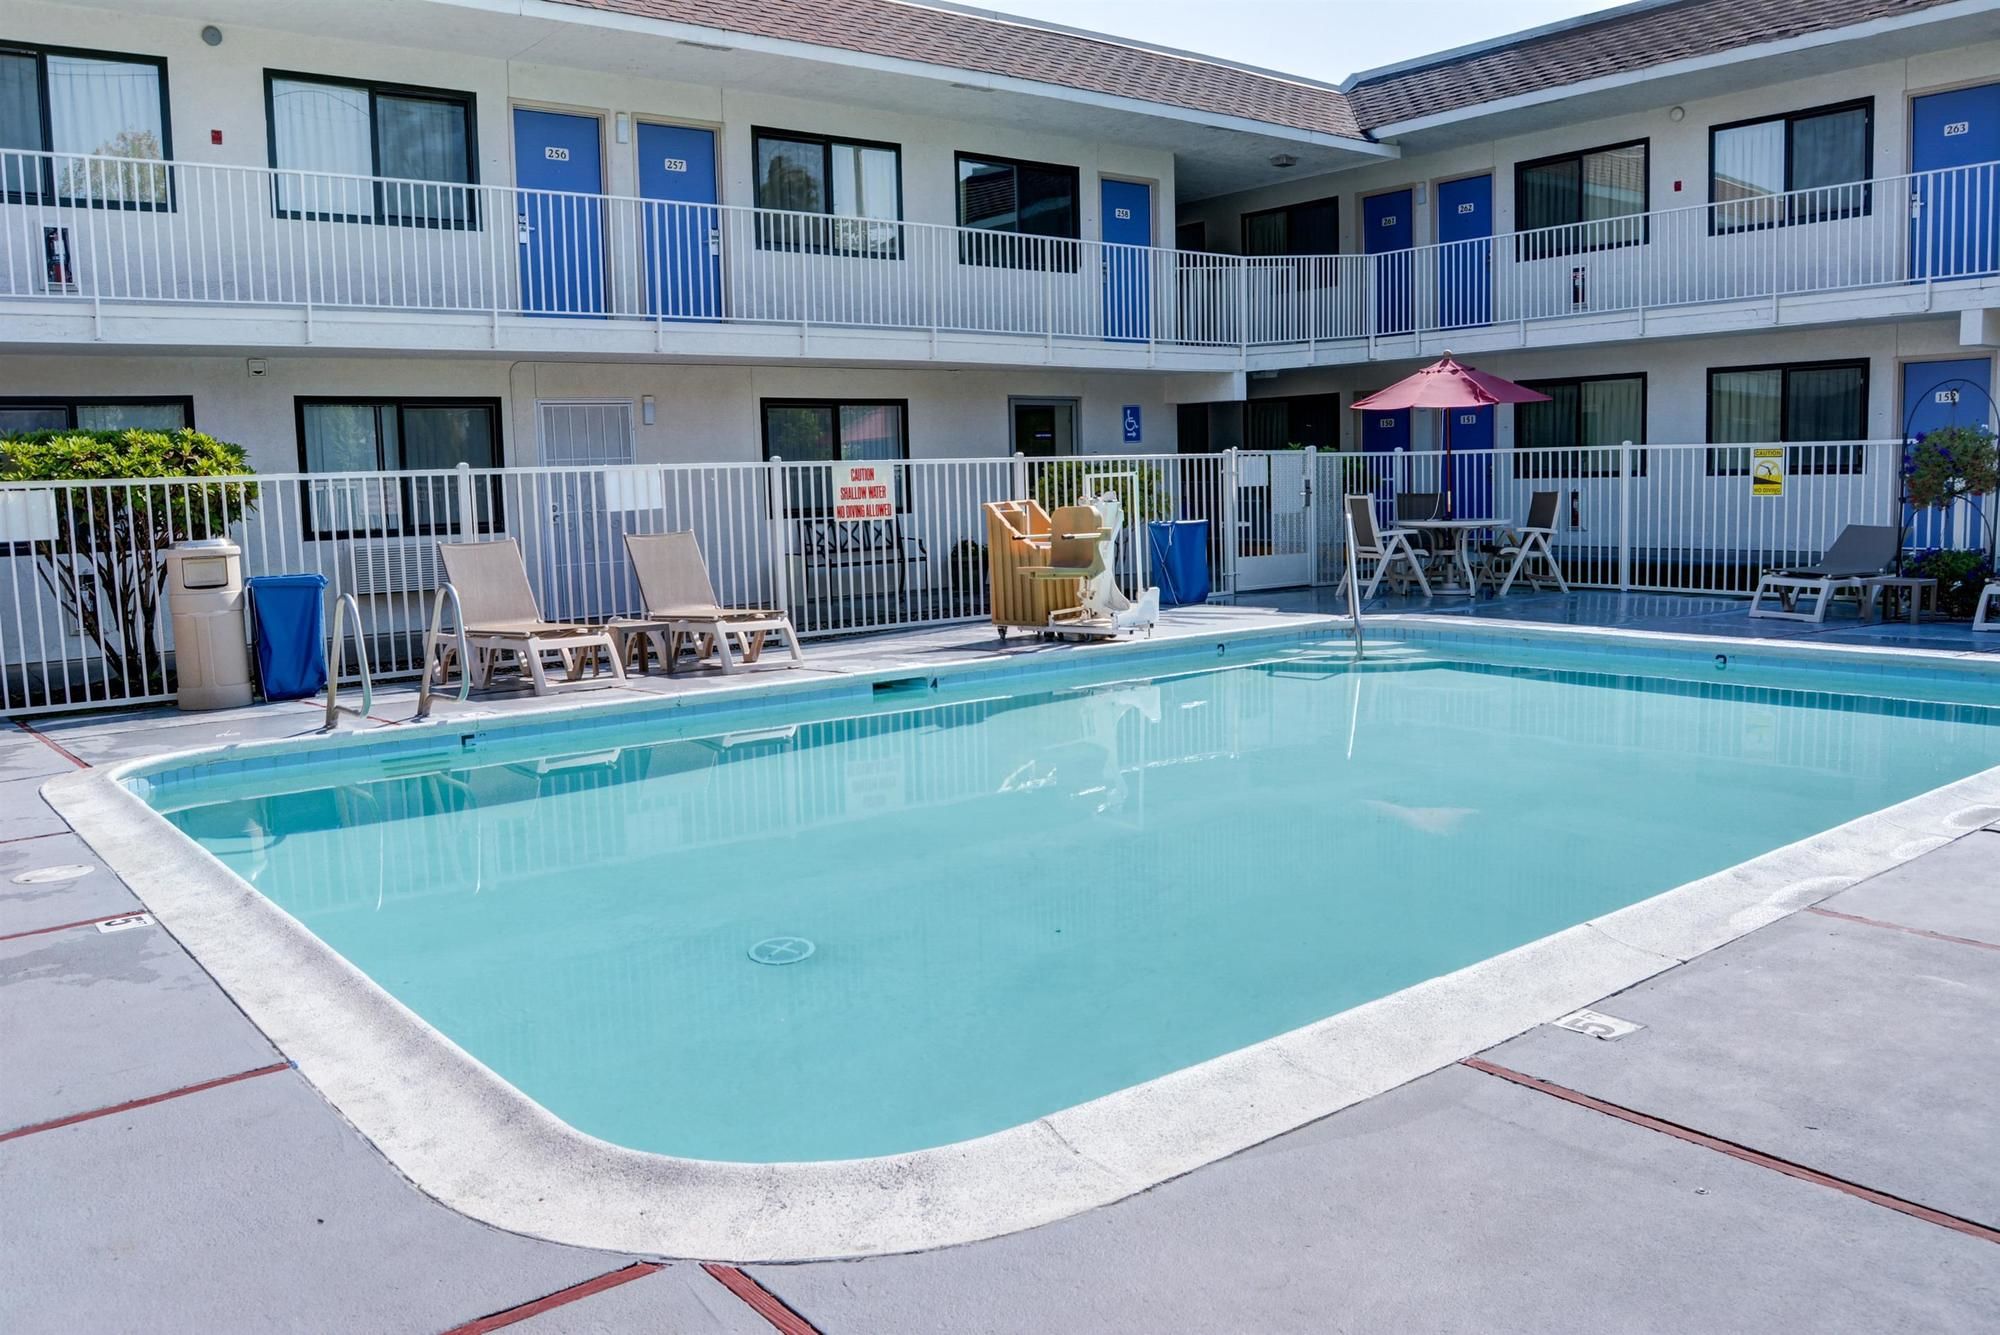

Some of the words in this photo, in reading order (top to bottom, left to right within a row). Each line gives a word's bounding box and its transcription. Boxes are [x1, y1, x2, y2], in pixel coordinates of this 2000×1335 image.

[1946, 123, 1966, 135] 263
[547, 149, 567, 159] 256
[666, 160, 684, 170] 257
[1116, 209, 1129, 218] 258
[1460, 204, 1473, 213] 262
[1383, 217, 1395, 225] 261
[1381, 419, 1393, 427] 150
[1462, 415, 1475, 424] 151
[850, 467, 875, 481] CAUTION
[840, 486, 866, 500] SHALLOW
[868, 485, 887, 499] WATER
[836, 505, 845, 518] NO
[846, 504, 865, 518] DIVING
[866, 503, 892, 517] ALLOWED
[1563, 1017, 1616, 1036] 5
